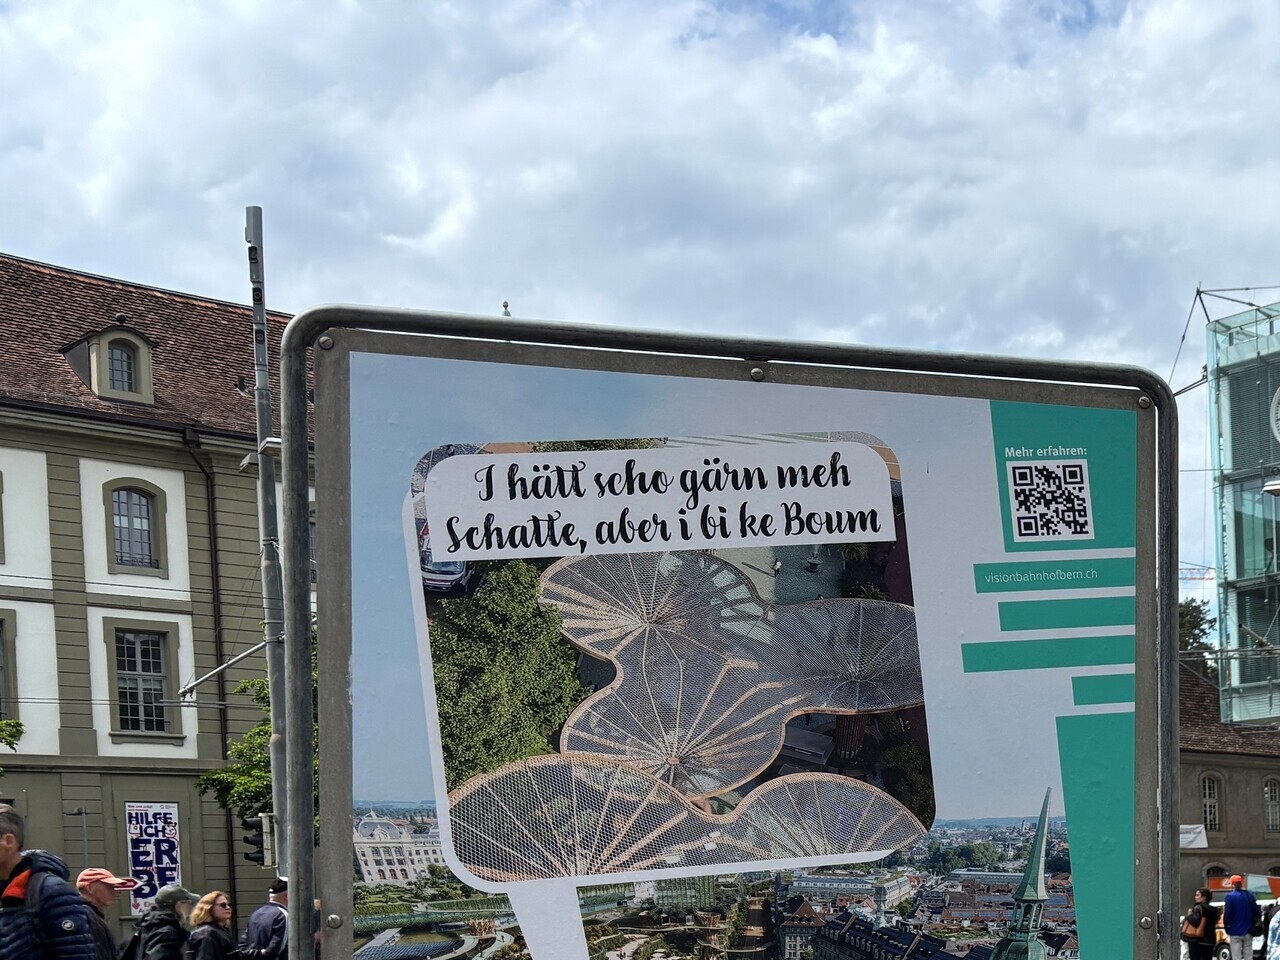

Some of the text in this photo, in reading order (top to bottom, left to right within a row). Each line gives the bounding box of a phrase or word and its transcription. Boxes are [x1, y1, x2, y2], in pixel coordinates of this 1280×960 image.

[1005, 446, 1088, 457] Mehr erfahren:
[474, 451, 852, 510] I hätt scho gärn meh
[445, 501, 882, 554] Schatte, aber i bi ke Boum
[984, 568, 1098, 583] visionbahnhofbern.ch
[128, 812, 177, 827] HILFE,
[140, 825, 166, 838] ICH
